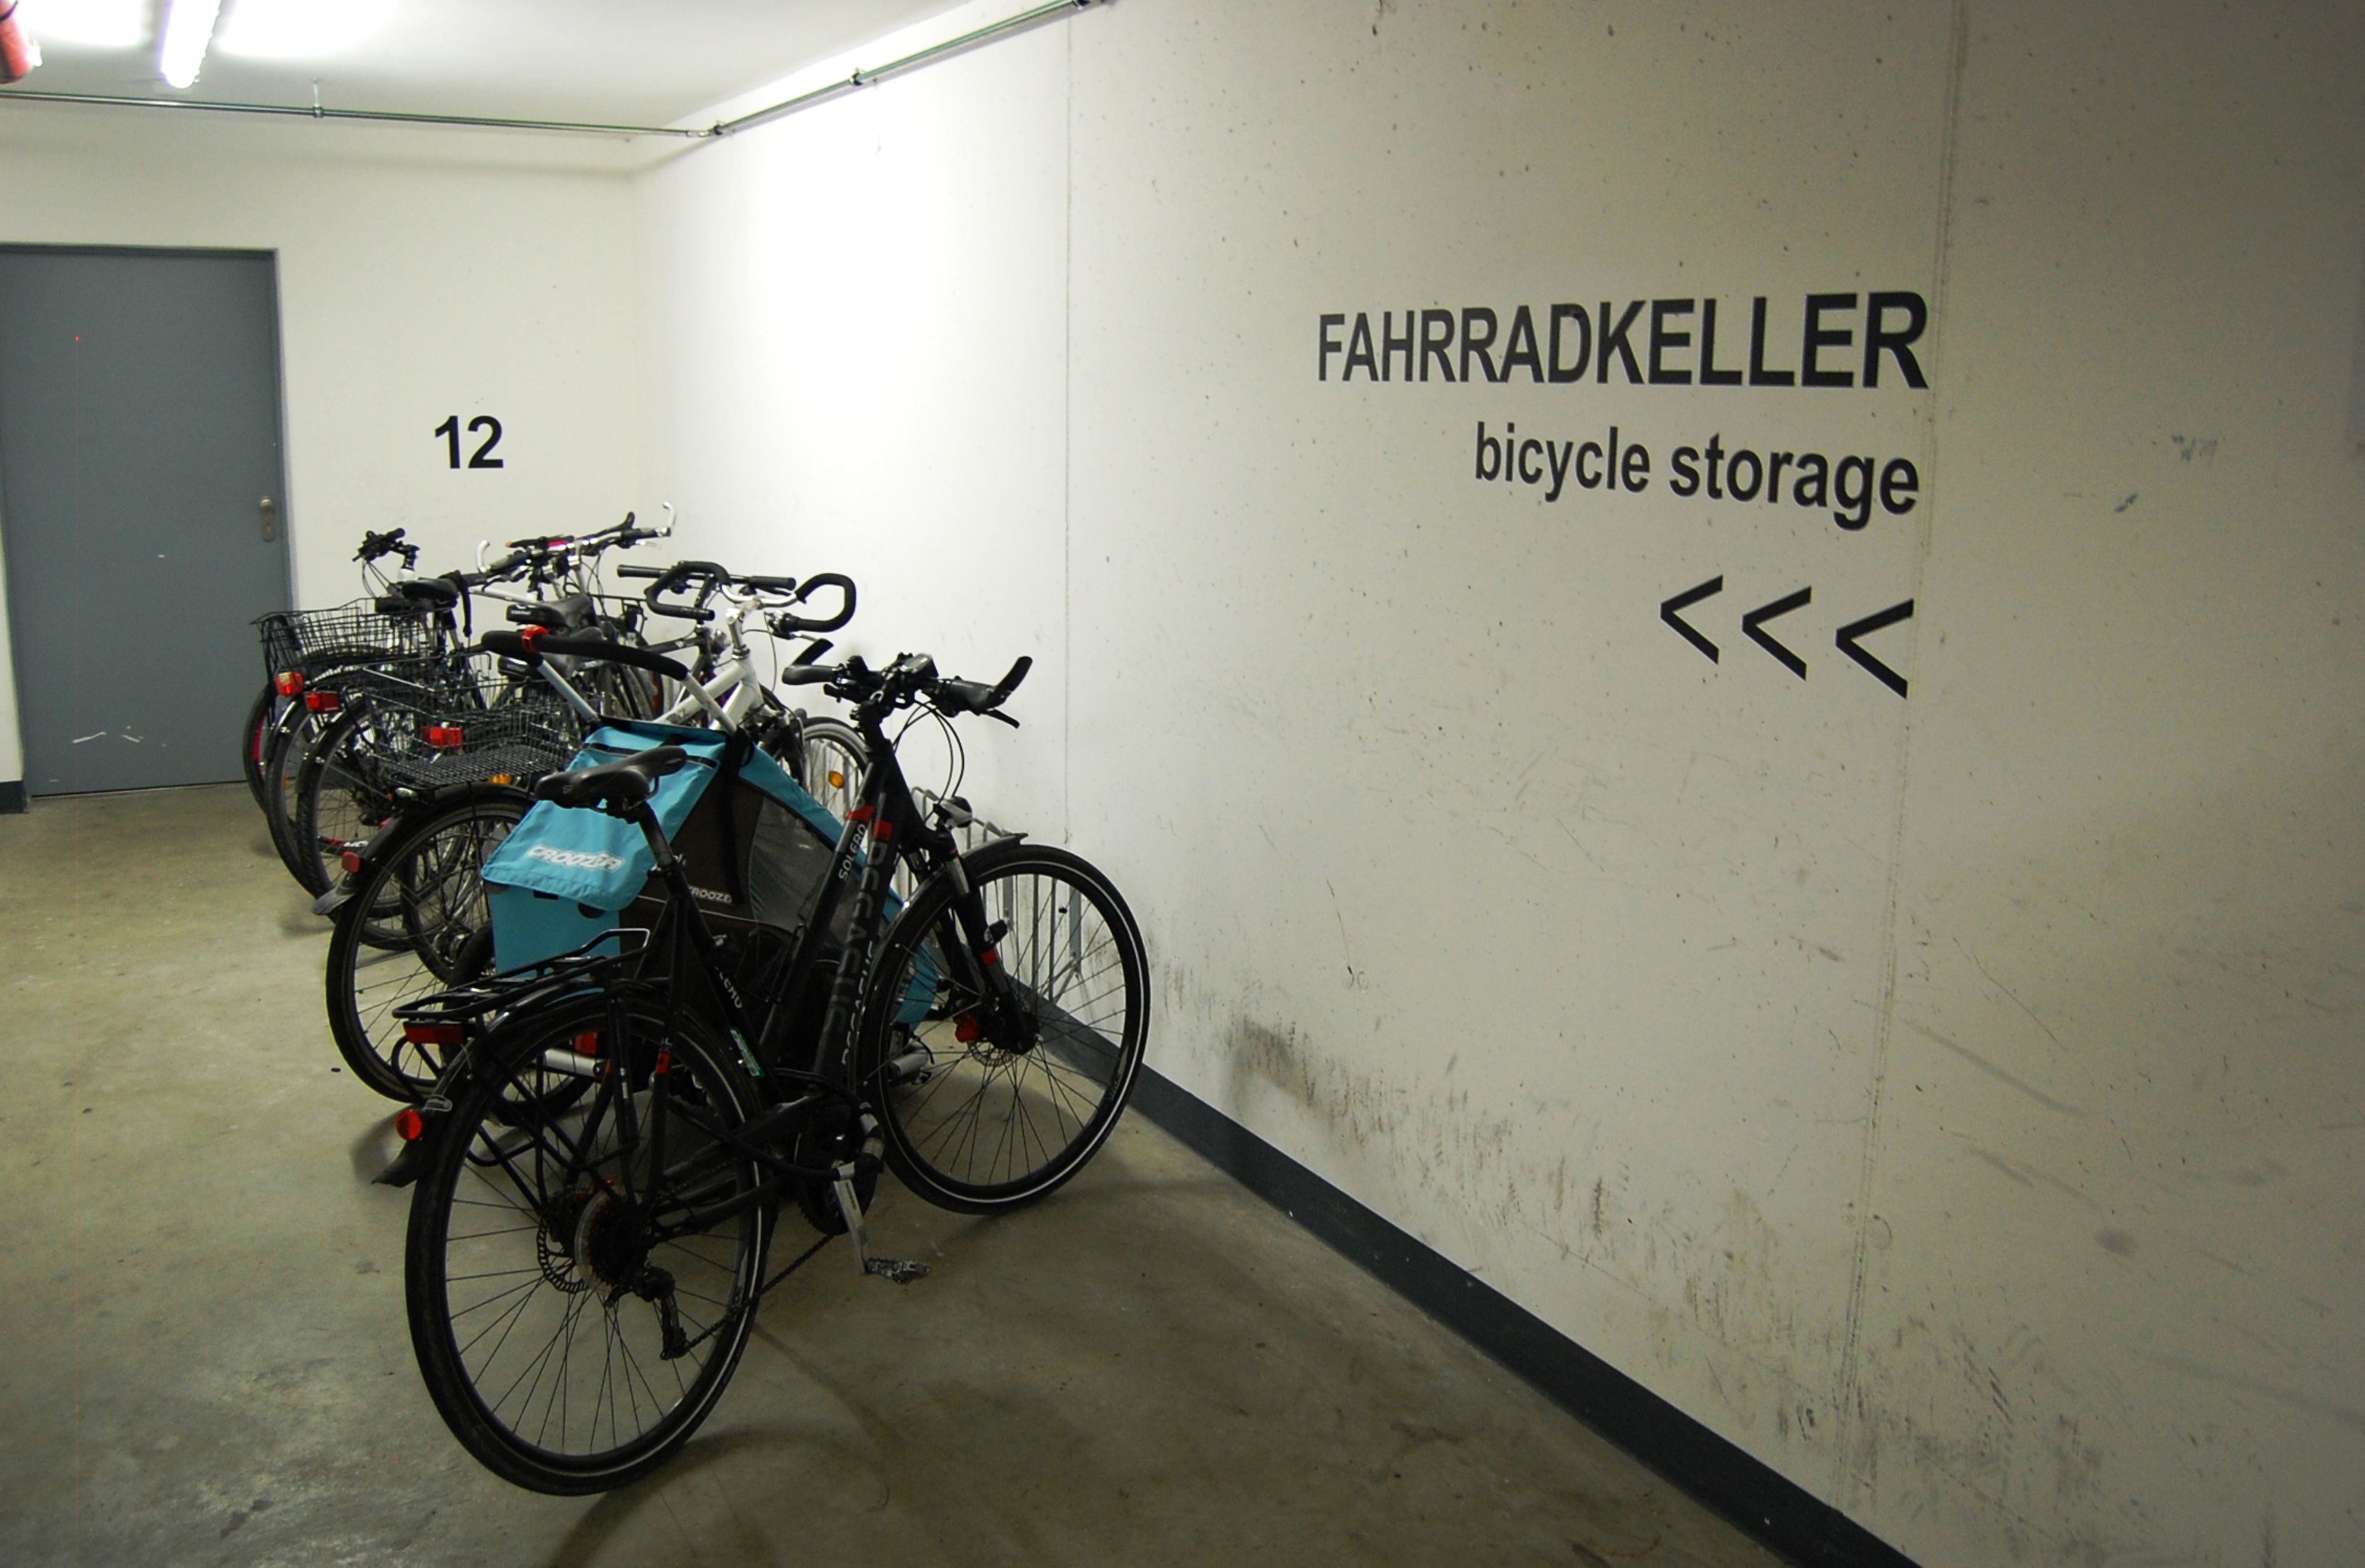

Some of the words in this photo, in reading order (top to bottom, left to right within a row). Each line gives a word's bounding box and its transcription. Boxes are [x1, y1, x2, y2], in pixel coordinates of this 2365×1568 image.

[1319, 291, 1928, 389] FAHRRADKELLER
[435, 415, 504, 469] 12
[1476, 421, 1650, 502] bicycle
[1669, 433, 1919, 531] storage
[838, 823, 867, 881] SOLERO
